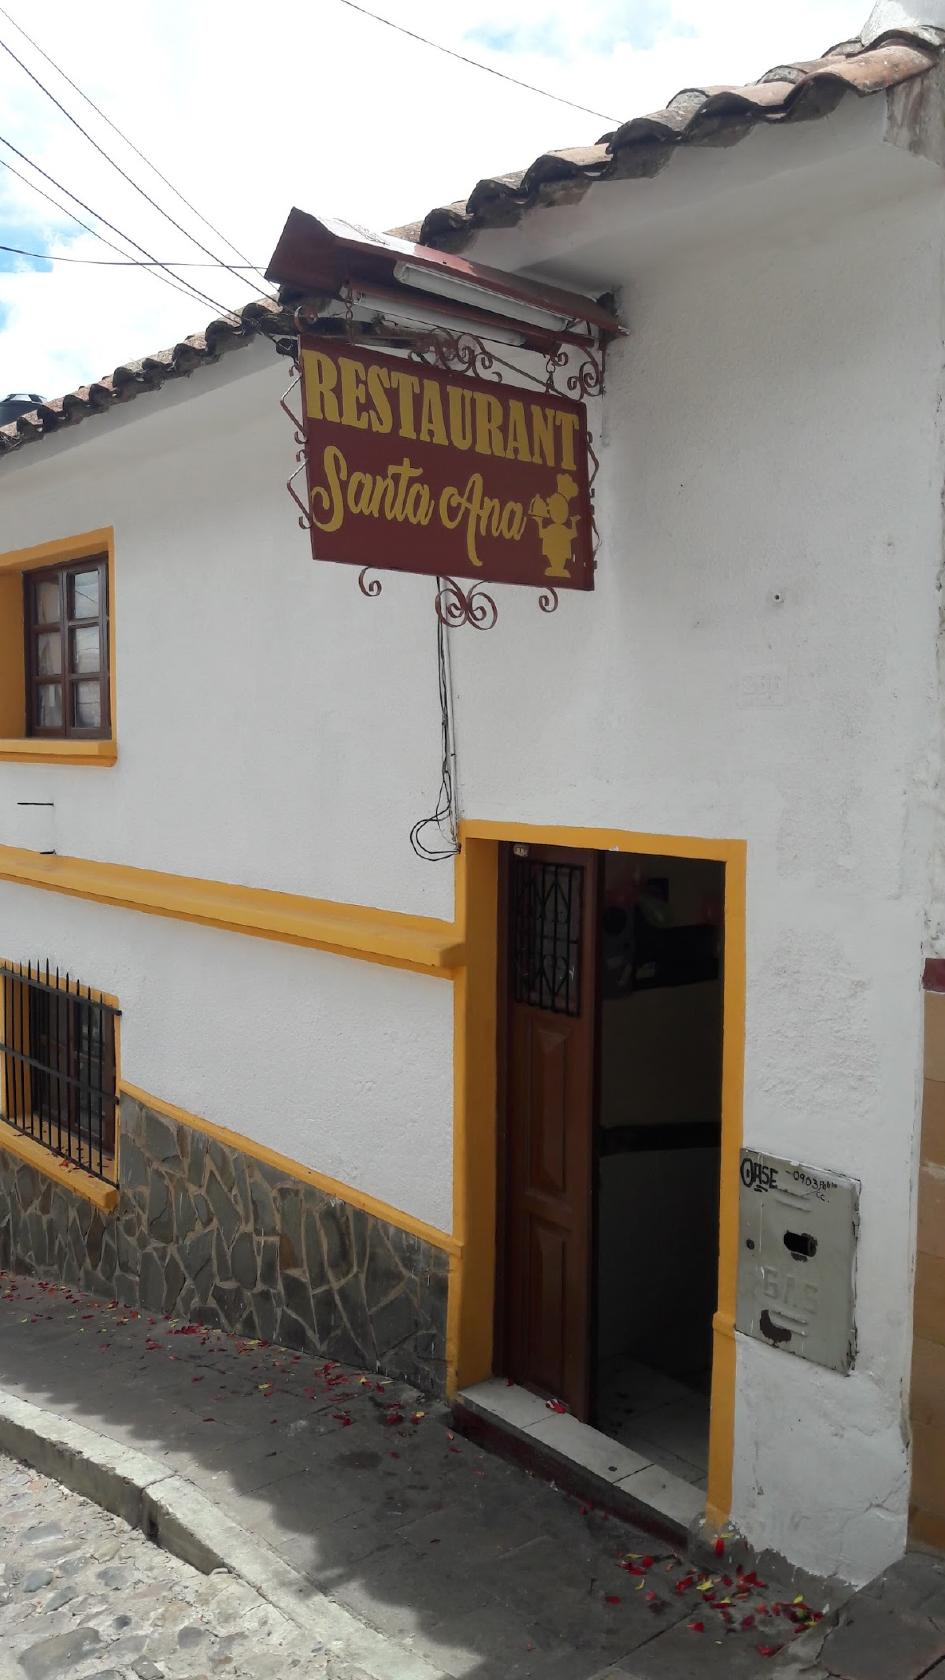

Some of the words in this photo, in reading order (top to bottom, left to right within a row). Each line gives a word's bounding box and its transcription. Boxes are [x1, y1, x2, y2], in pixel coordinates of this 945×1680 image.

[302, 349, 579, 471] RESTAURANT
[311, 446, 435, 532] Santa
[440, 473, 527, 567] Ana
